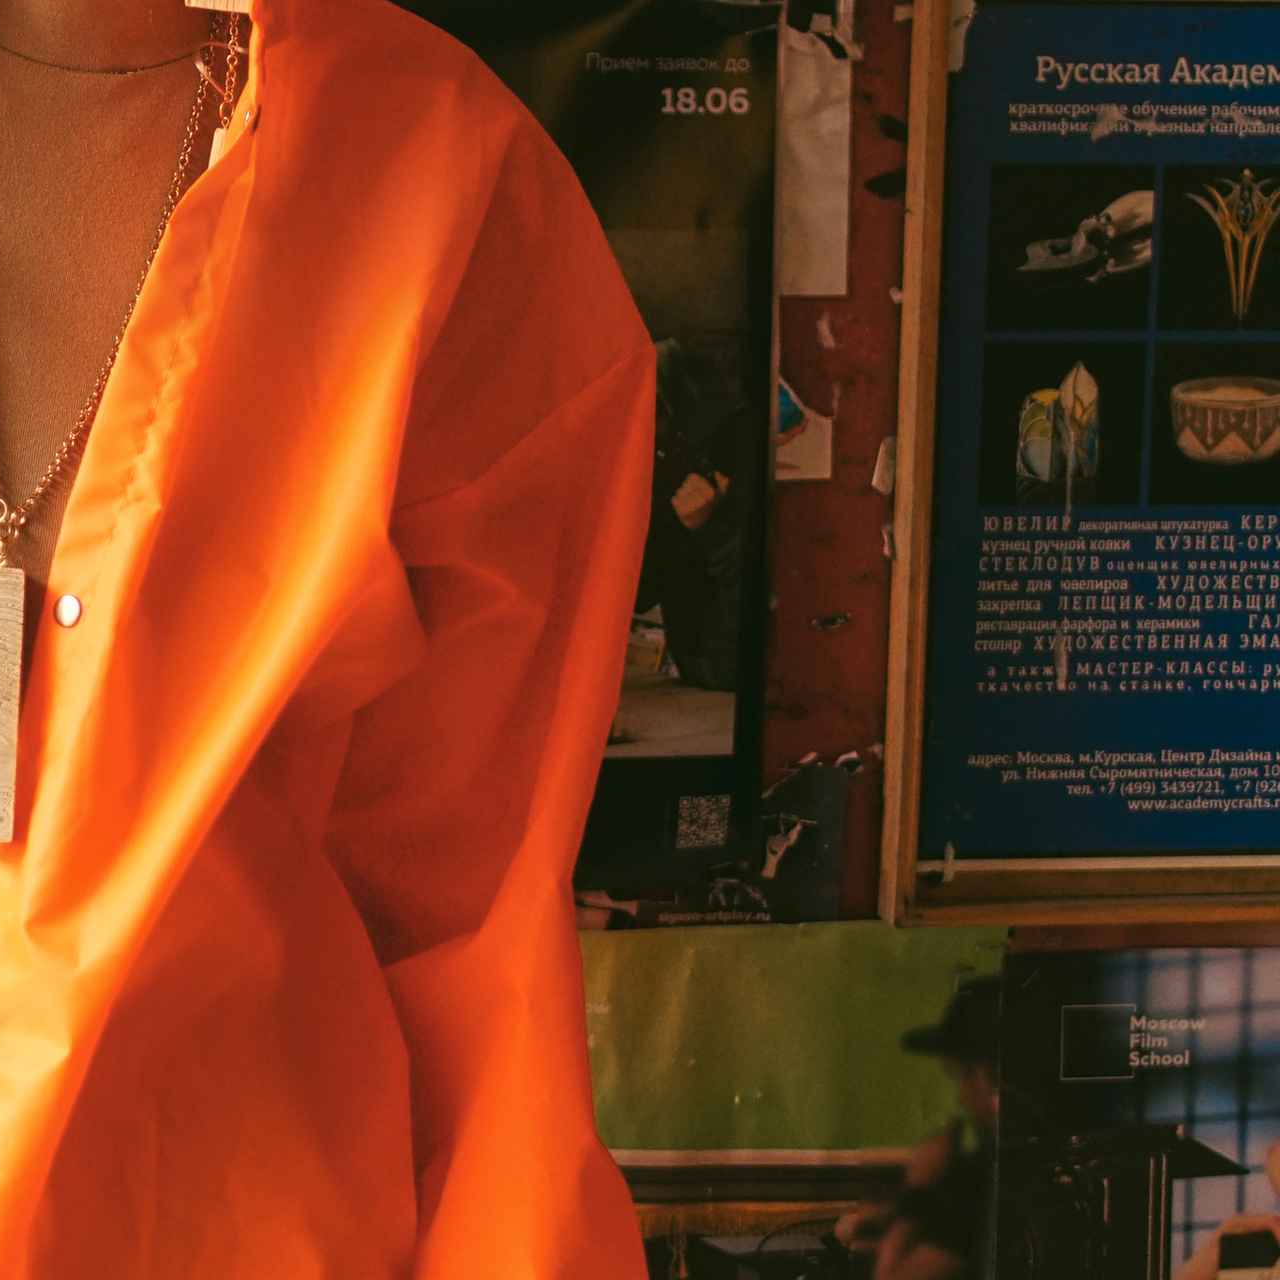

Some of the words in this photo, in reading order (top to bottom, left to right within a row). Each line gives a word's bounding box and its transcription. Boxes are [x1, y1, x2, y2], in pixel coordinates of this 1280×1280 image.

[585, 52, 650, 73] Прием
[654, 55, 719, 72] заявок
[723, 55, 751, 75] до
[1035, 55, 1161, 90] Русская
[661, 86, 751, 115] 18.06
[1131, 101, 1207, 120] обучение
[982, 515, 1072, 532] ЮВЕЛИР
[1077, 519, 1158, 533] декоративная
[1160, 520, 1230, 533] штукатурка
[1240, 514, 1280, 531] КЕР
[981, 538, 1031, 553] кузнец
[1034, 537, 1086, 554] ручной
[1089, 538, 1131, 551] ковки
[978, 555, 1101, 574] СТЕКЛОДУВ
[1106, 559, 1180, 572] оценщик
[977, 578, 1019, 592] литье
[1025, 579, 1052, 593] для
[1060, 577, 1129, 593] ювелиров
[1156, 574, 1280, 593] ХУДОЖЕСТВ
[976, 598, 1042, 613] закрепка
[1057, 594, 1277, 613] ЛЕПЩИК-МОДЕЛЬЩИ
[975, 618, 1057, 634] реставрация
[1060, 617, 1117, 634] фарфора
[1136, 618, 1200, 631] керамики
[974, 638, 1023, 652] столяр
[1033, 634, 1229, 653] ХУДОЖЕСТВЕННАЯ
[1076, 661, 1254, 676] МАСТЕР-КЛАССЫ:
[1088, 680, 1111, 690] на
[1119, 679, 1192, 692] станке,
[967, 751, 1014, 766] адрес:
[1016, 751, 1076, 766] Москва,
[1078, 749, 1156, 768] м.Курская,
[1160, 750, 1205, 767] Центр
[1208, 748, 1272, 766] Дизайна
[1000, 768, 1022, 783] ул.
[1026, 767, 1085, 781] Нижняя
[1088, 766, 1226, 783] Сыромятническая,
[1228, 767, 1259, 780] дом
[1066, 783, 1094, 795] тел.
[1099, 781, 1117, 794] +7
[1119, 780, 1157, 797] (499)
[1160, 780, 1225, 797] 3439721,
[1233, 781, 1251, 793] +7
[1129, 1014, 1206, 1031] Moscow
[1129, 1032, 1169, 1048] Film
[1128, 1049, 1191, 1067] School
